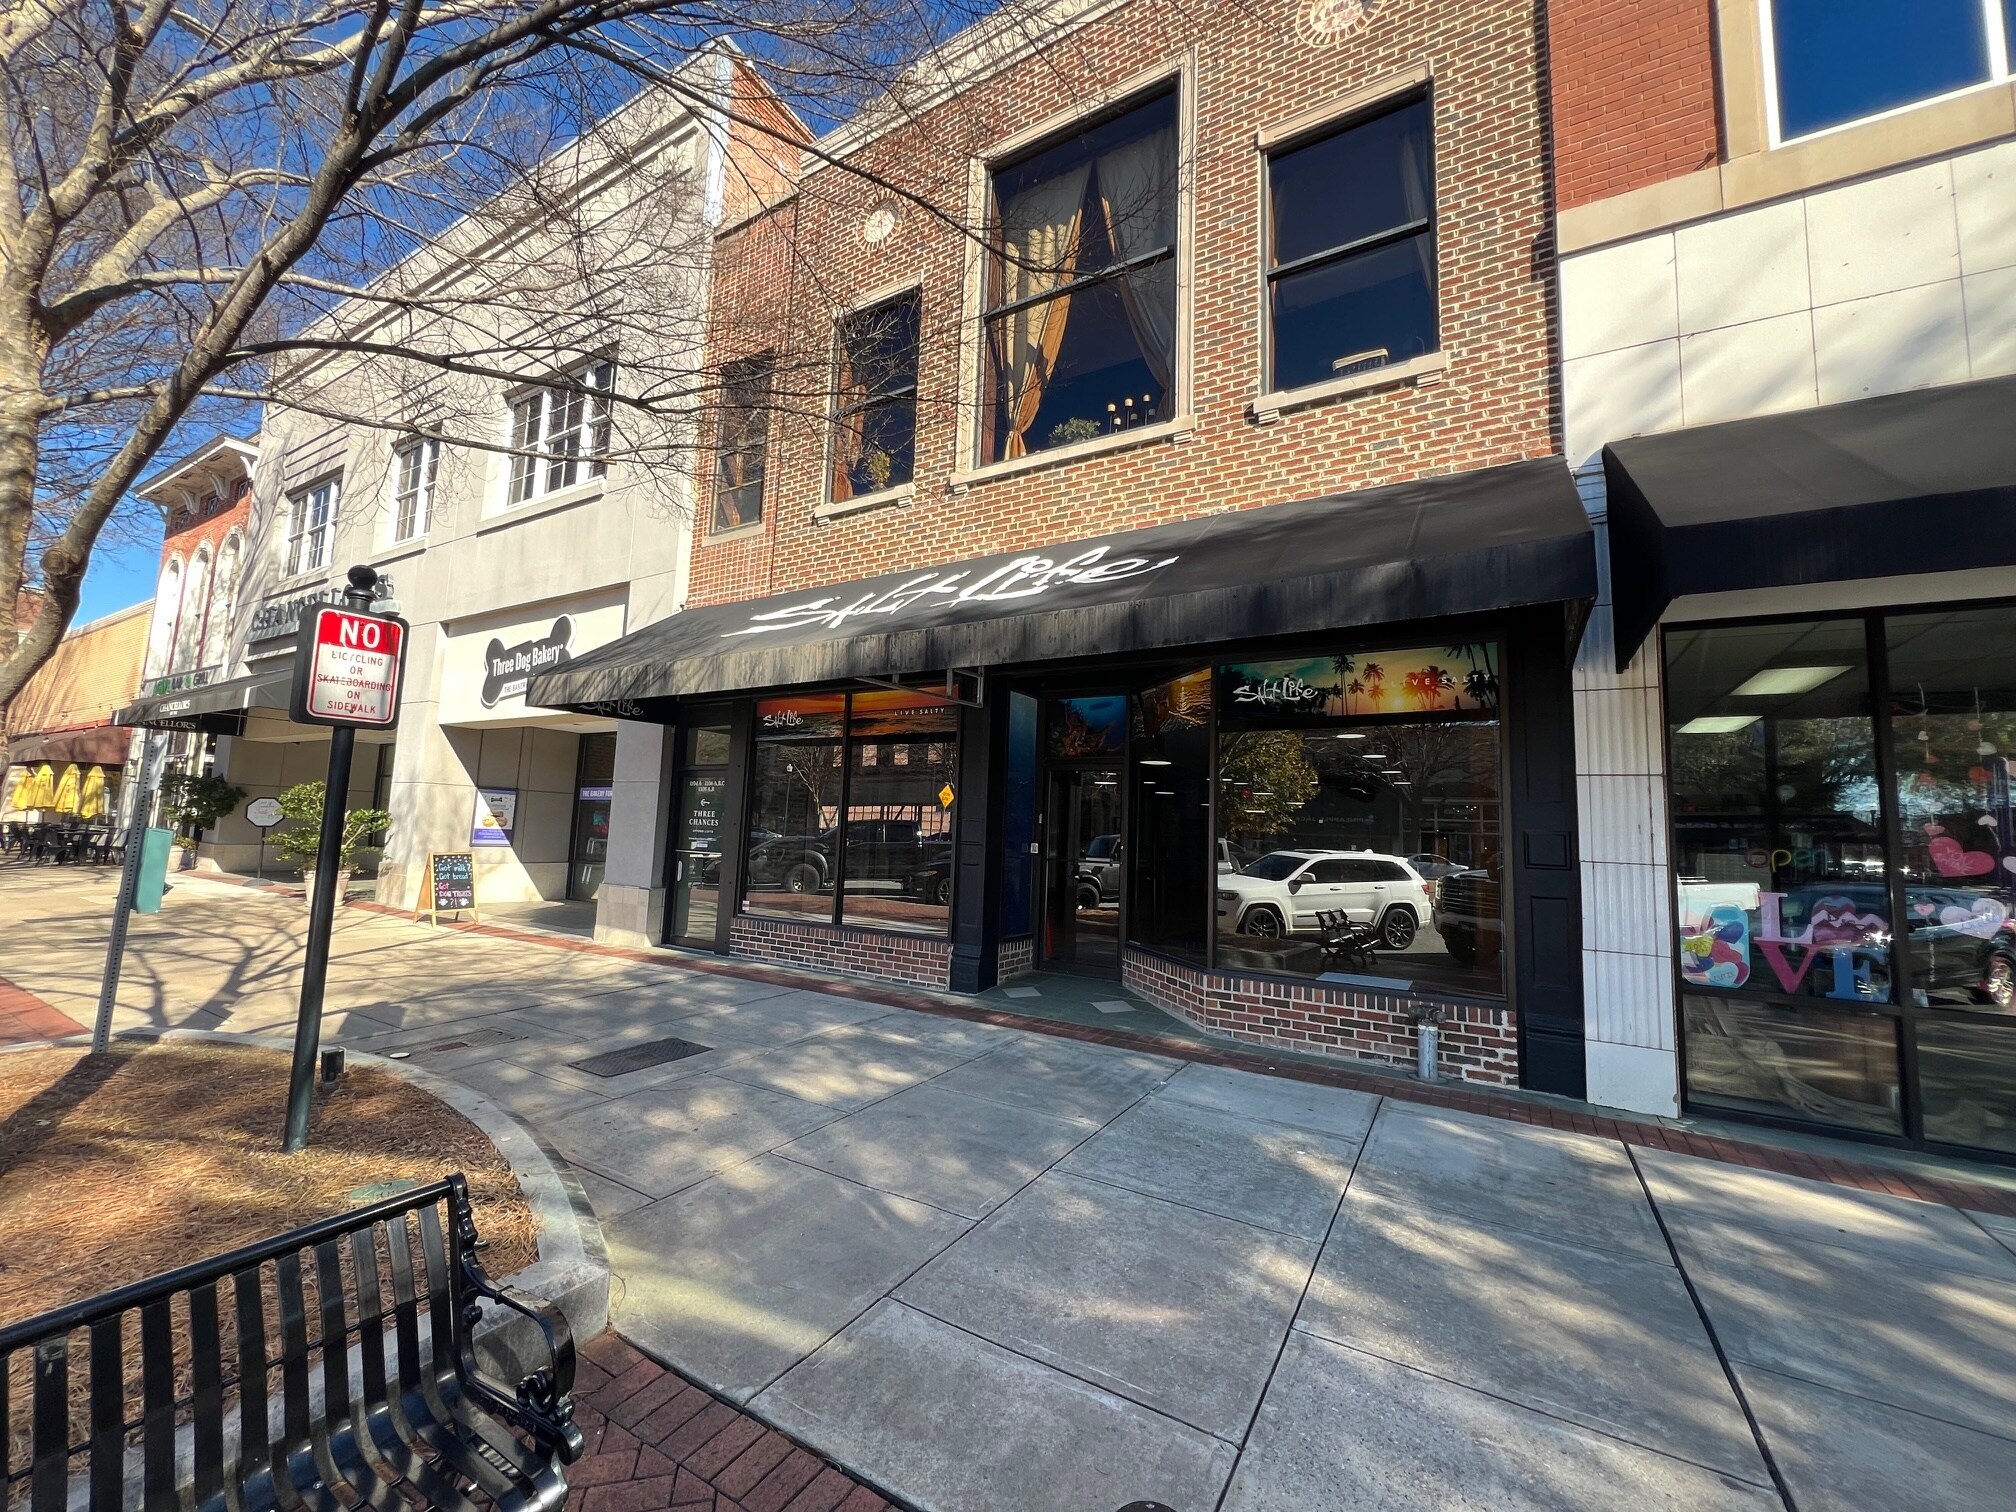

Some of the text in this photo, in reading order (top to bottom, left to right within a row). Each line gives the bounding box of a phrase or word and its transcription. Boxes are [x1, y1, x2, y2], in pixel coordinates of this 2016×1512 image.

[340, 618, 380, 648] NO
[493, 644, 561, 676] Three Dog Bakery
[350, 666, 363, 676] OR
[316, 674, 391, 692] SKATEBOARDING
[1391, 674, 1491, 688] LIVE SALTY
[504, 681, 526, 693] THE BAKER
[347, 690, 360, 700] ON
[327, 700, 376, 714] SIDEWALK
[894, 707, 945, 717] LIVE SALTY
[688, 818, 719, 827] CHANCES
[438, 863, 451, 871] Got
[439, 872, 450, 880] Got
[438, 882, 450, 890] Got
